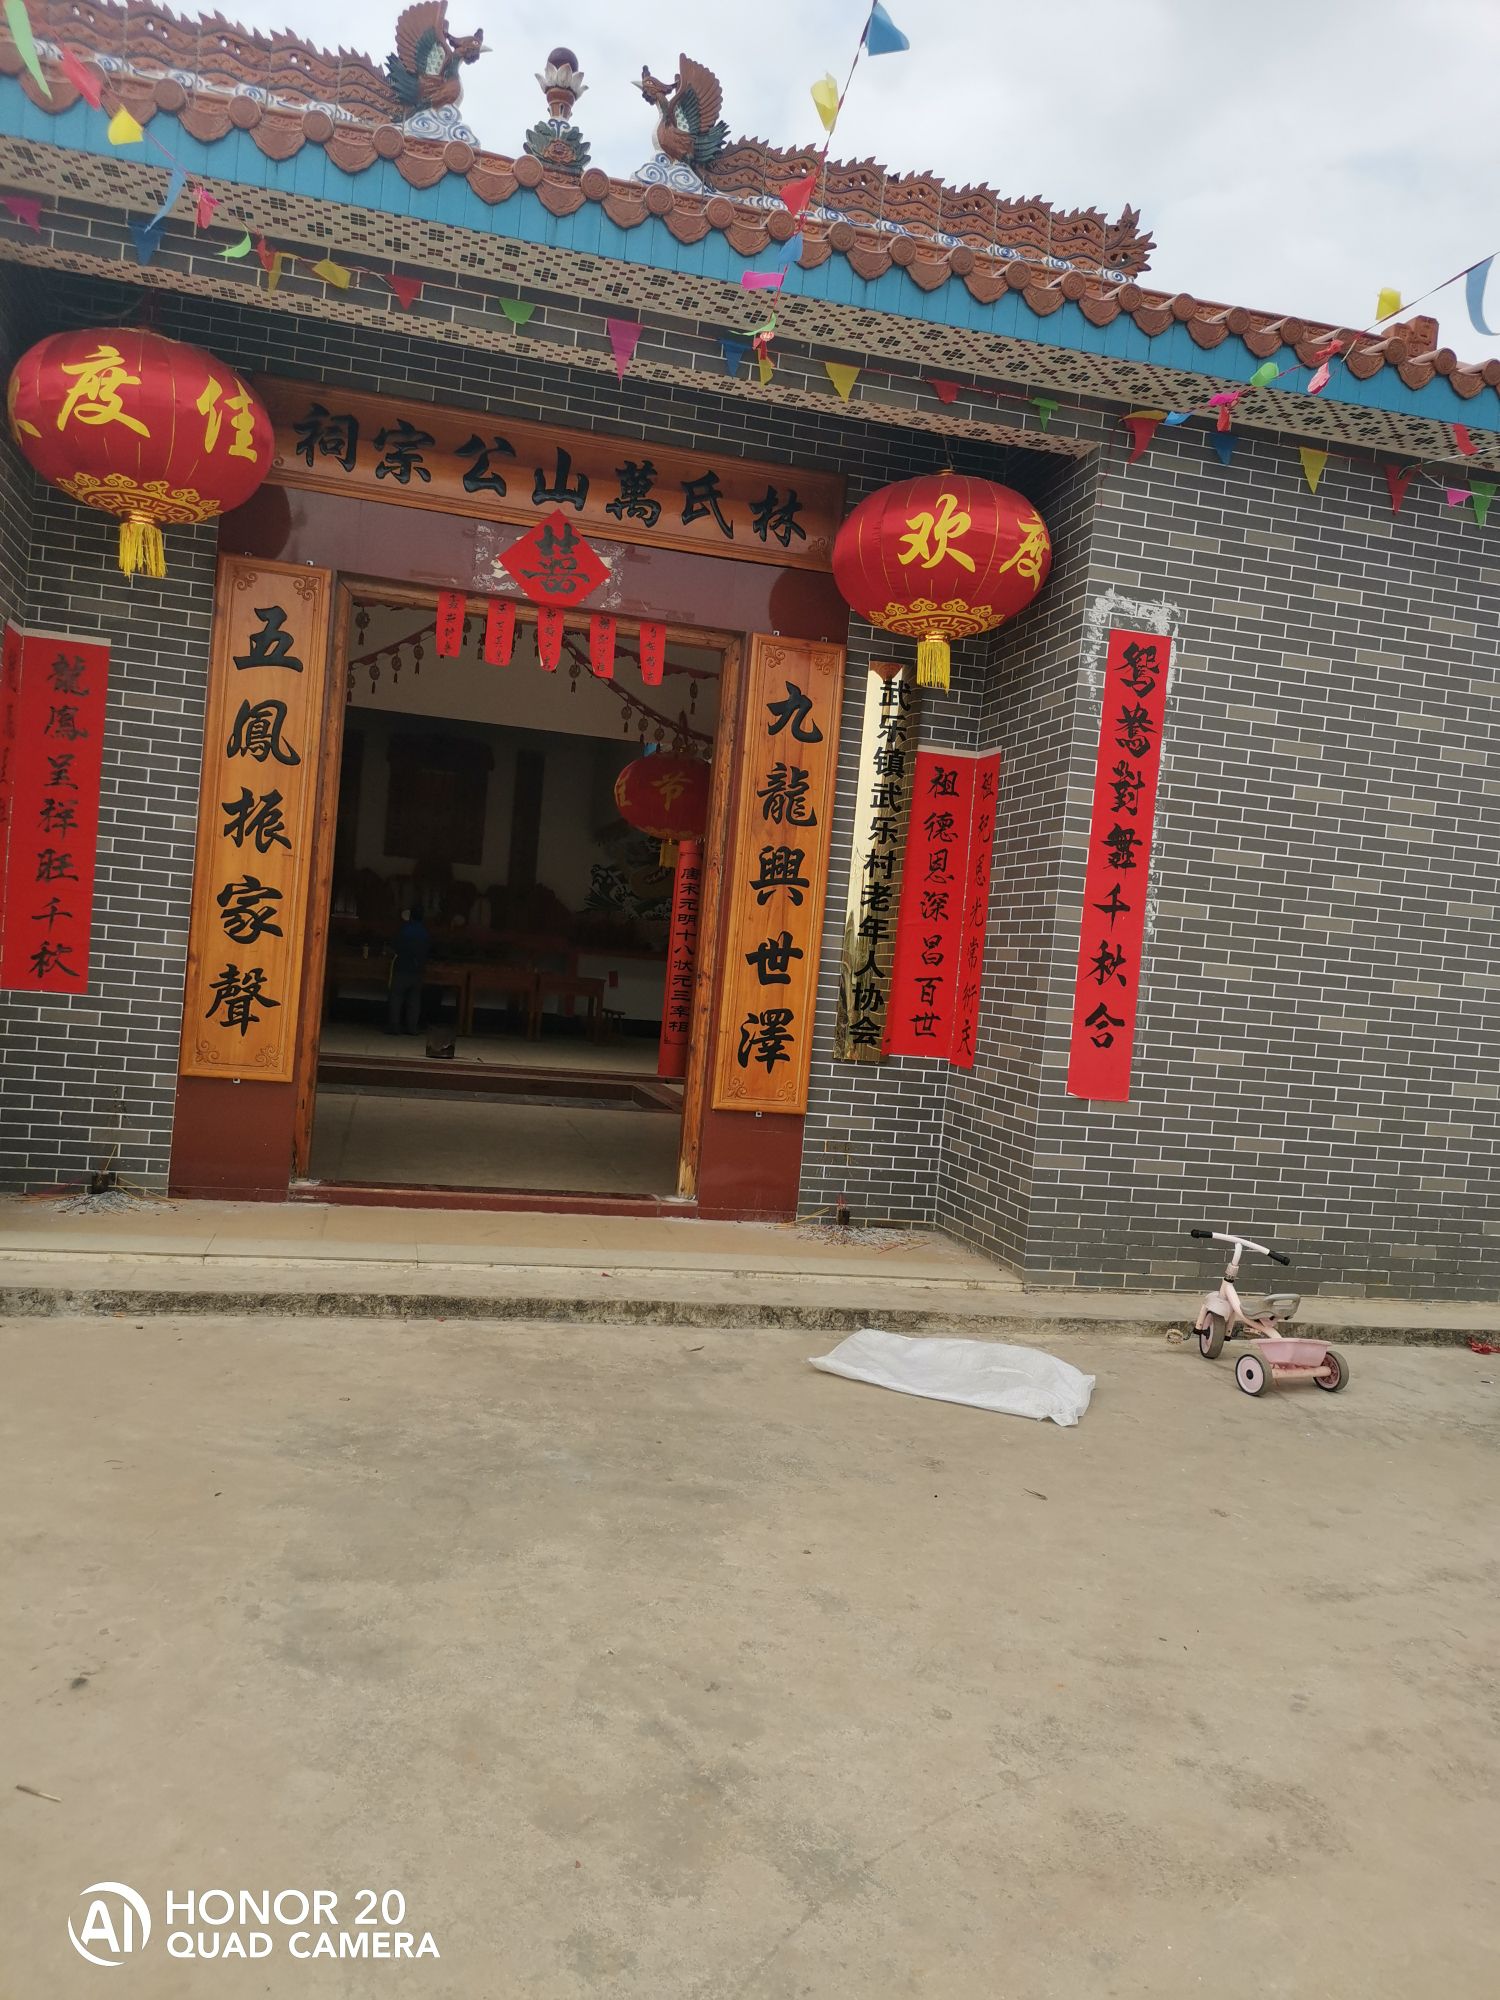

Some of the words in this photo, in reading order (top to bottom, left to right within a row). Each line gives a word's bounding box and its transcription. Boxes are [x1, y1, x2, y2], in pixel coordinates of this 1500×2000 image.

[897, 493, 1050, 592] 欢度
[205, 606, 304, 1037] 五鳳振家聲
[737, 681, 824, 1074] 九龍興世澤
[849, 680, 912, 1046] 武乐镇武乐村老年人协会
[908, 766, 960, 1038] 祖德恩深昌百世
